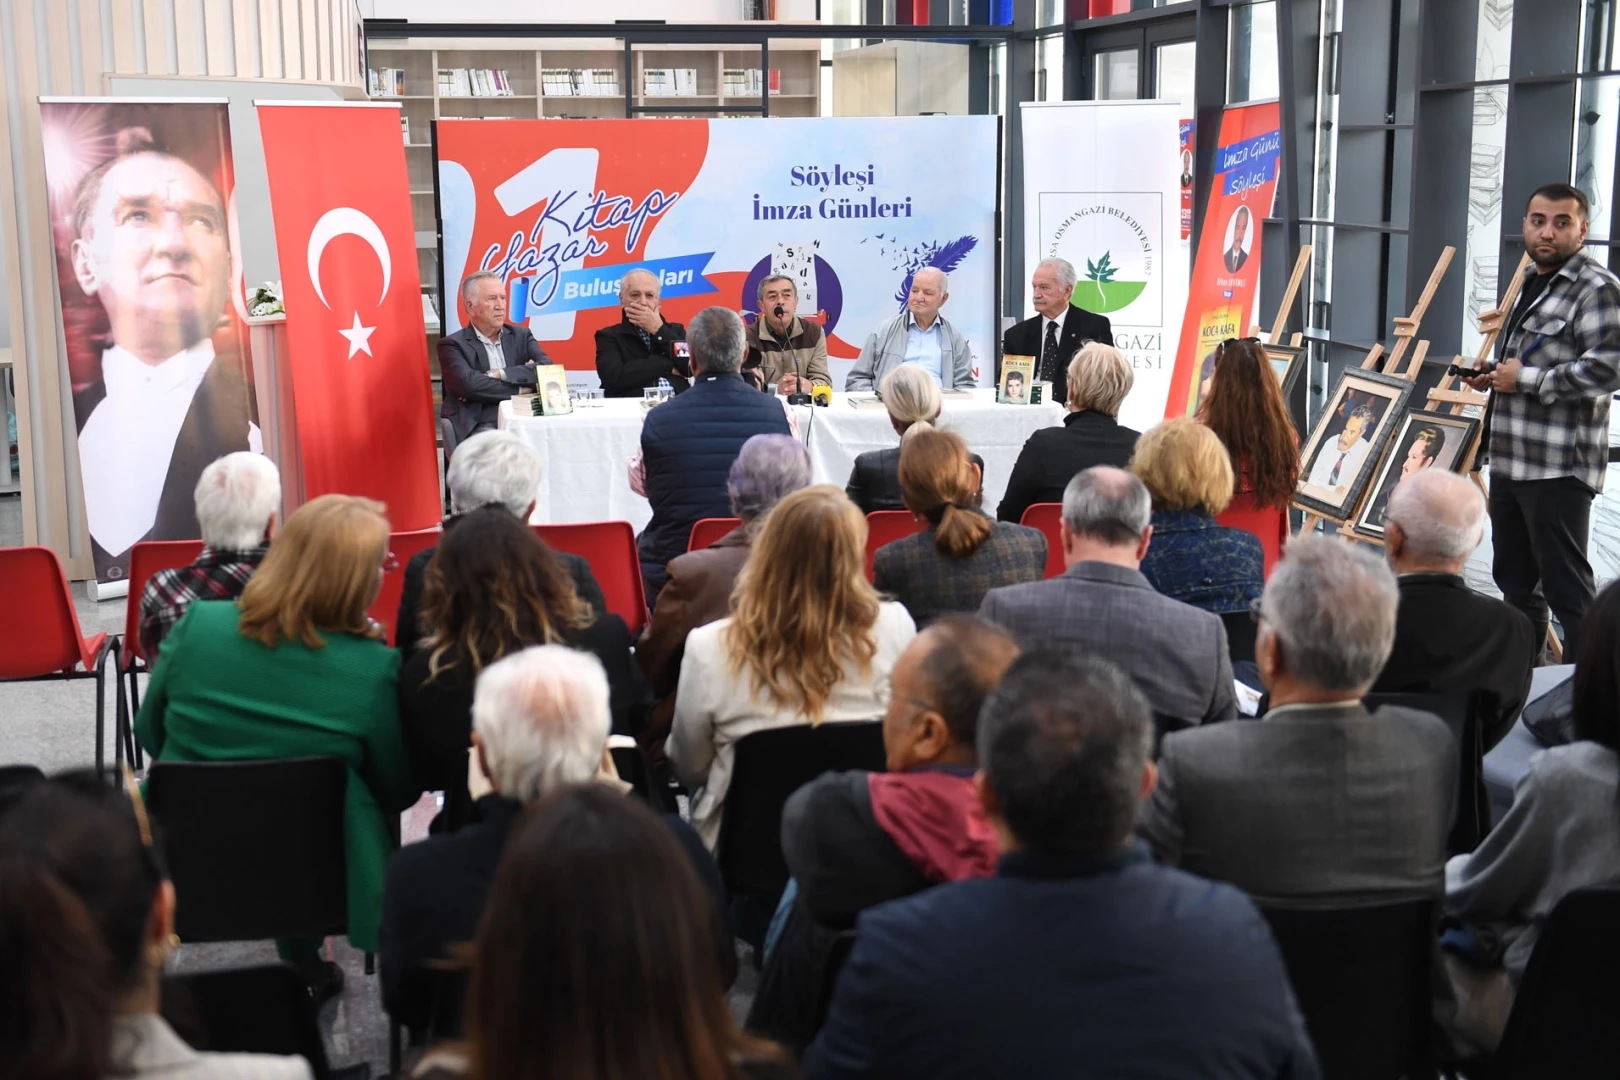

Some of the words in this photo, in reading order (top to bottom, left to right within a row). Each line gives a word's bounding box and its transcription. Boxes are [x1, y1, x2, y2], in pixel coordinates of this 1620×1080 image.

[1250, 132, 1280, 161] Günü
[790, 164, 874, 193] Söyleşi
[530, 189, 679, 252] Kitap
[752, 193, 813, 220] İmza
[818, 196, 912, 220] Günleri
[1055, 204, 1106, 240] OSMANGAZİ
[1107, 207, 1153, 253] BELEDİYESİ
[482, 233, 608, 307] Yazar
[563, 268, 694, 300] Buluşları
